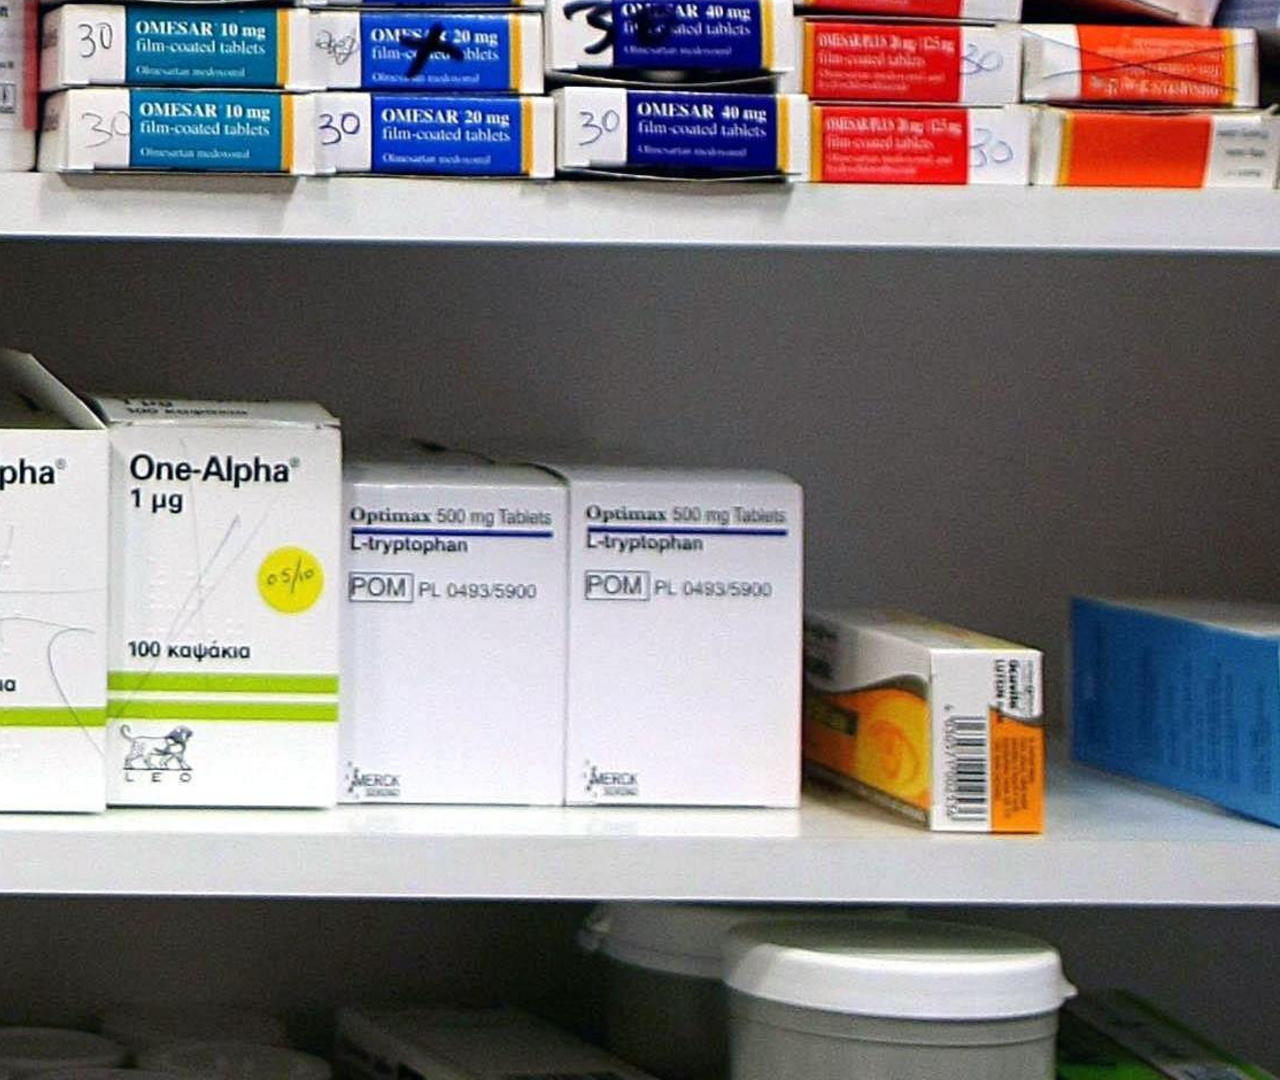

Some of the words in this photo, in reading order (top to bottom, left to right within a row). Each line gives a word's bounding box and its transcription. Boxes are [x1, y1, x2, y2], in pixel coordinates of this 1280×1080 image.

[131, 489, 141, 508] 1
[153, 492, 183, 515] µg
[350, 507, 432, 526] Optimax
[437, 508, 465, 523] 500
[470, 512, 494, 527] mg
[498, 508, 552, 525] Tablets
[350, 537, 468, 554] L-tryptophan
[351, 577, 407, 598] POM
[419, 582, 441, 598] PL
[447, 583, 536, 599] 0493/5900
